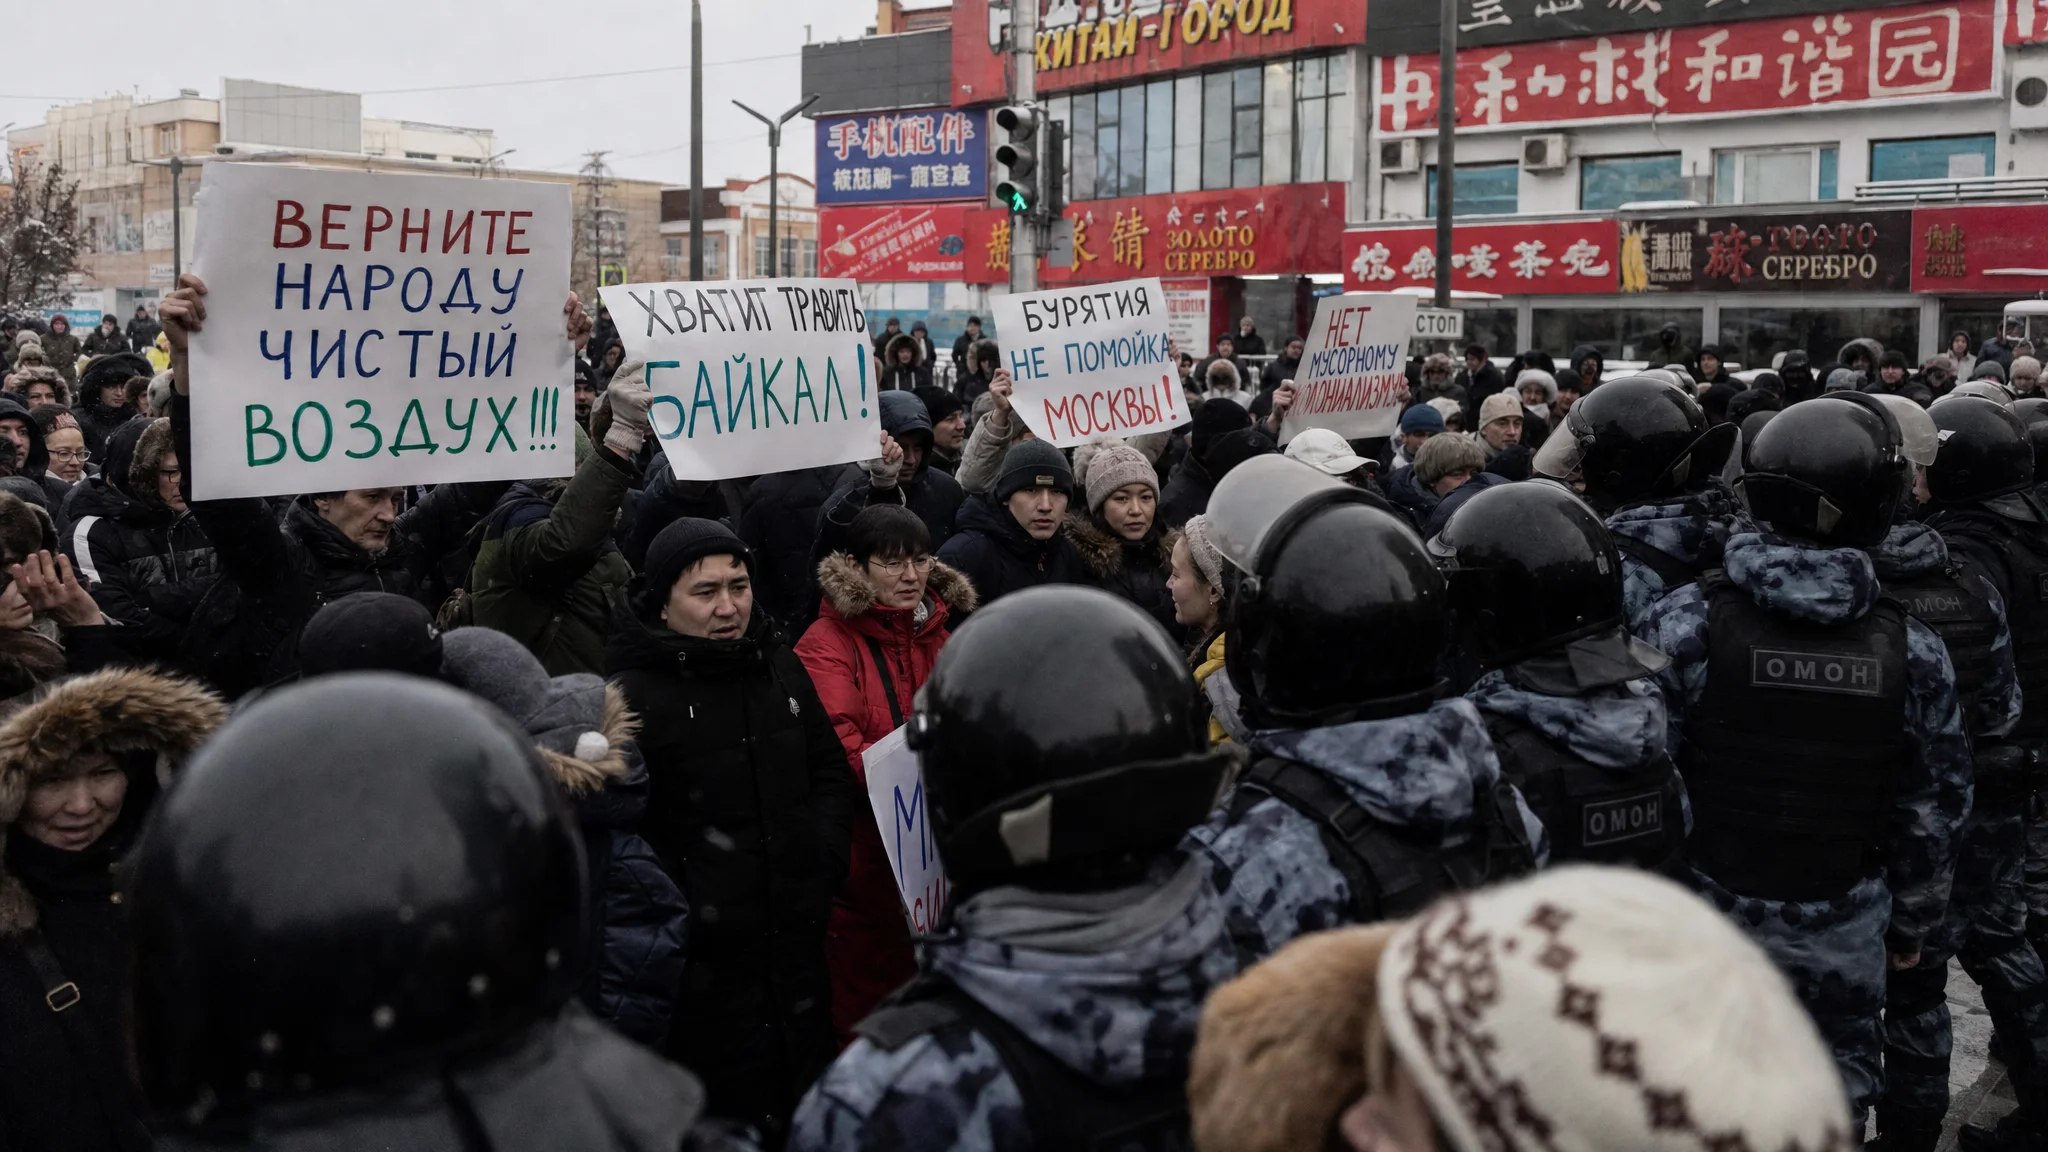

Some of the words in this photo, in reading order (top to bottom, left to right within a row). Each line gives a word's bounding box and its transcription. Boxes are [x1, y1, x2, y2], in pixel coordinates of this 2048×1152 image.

[273, 200, 533, 255] ВЕРНИТЕ
[1167, 225, 1255, 249] ЗОЛОТО
[1165, 250, 1255, 271] СЕРЕБРО
[1762, 254, 1877, 280] СЕРЕБРО
[275, 263, 524, 314] НАРОДУ
[628, 288, 772, 337] ХВАТИТ
[777, 286, 866, 333] ТРАВИТЬ
[1022, 287, 1151, 333] БУРЯТИЯ
[1325, 306, 1372, 349] НЕТ
[1416, 315, 1457, 333] СТОП
[260, 323, 517, 379] ЧИСТЫЙ
[1010, 347, 1049, 381] НЕ
[1064, 330, 1173, 374] ПОМОЙКА
[1308, 344, 1399, 379] МУСОРНОМУ
[645, 343, 868, 441] БАЙКАЛ!
[1044, 375, 1177, 441] МОСКВЫ!
[245, 386, 559, 467] ВОЗДУХ!!!
[1766, 657, 1868, 685] ОМОН
[1590, 803, 1658, 835] ОМОН
